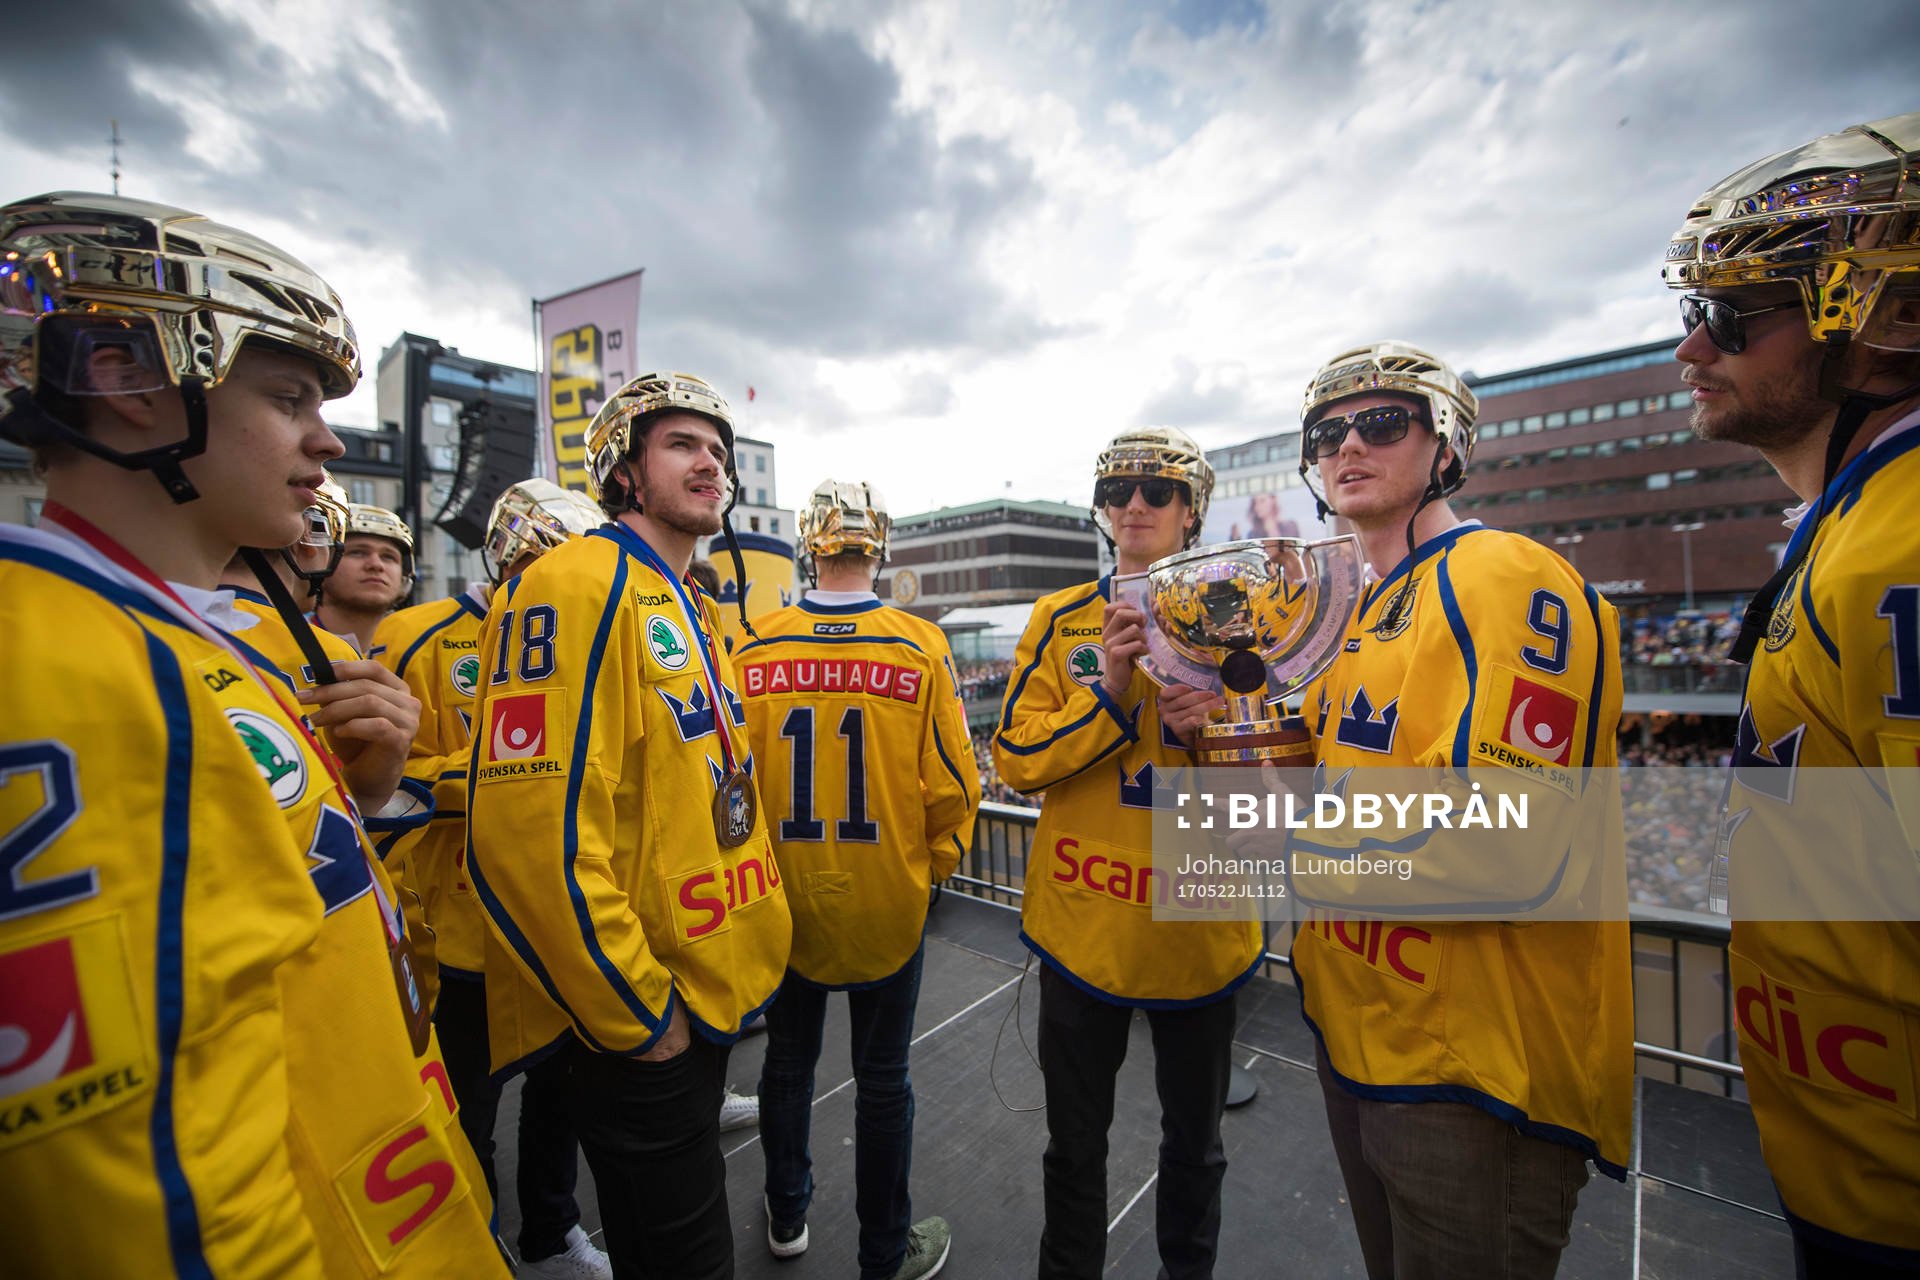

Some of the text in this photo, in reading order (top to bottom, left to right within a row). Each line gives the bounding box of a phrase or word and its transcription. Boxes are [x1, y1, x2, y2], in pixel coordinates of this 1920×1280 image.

[490, 603, 557, 686] 18
[815, 624, 856, 633] CCM
[1519, 587, 1571, 674] 9
[747, 663, 919, 696] BAUHAUS
[479, 761, 562, 780] SVENSKA SPEL
[779, 706, 880, 844] 11
[1479, 741, 1574, 793] SVENSKA SPEL
[0, 739, 99, 921] 2
[56, 1066, 143, 1116] SPEL
